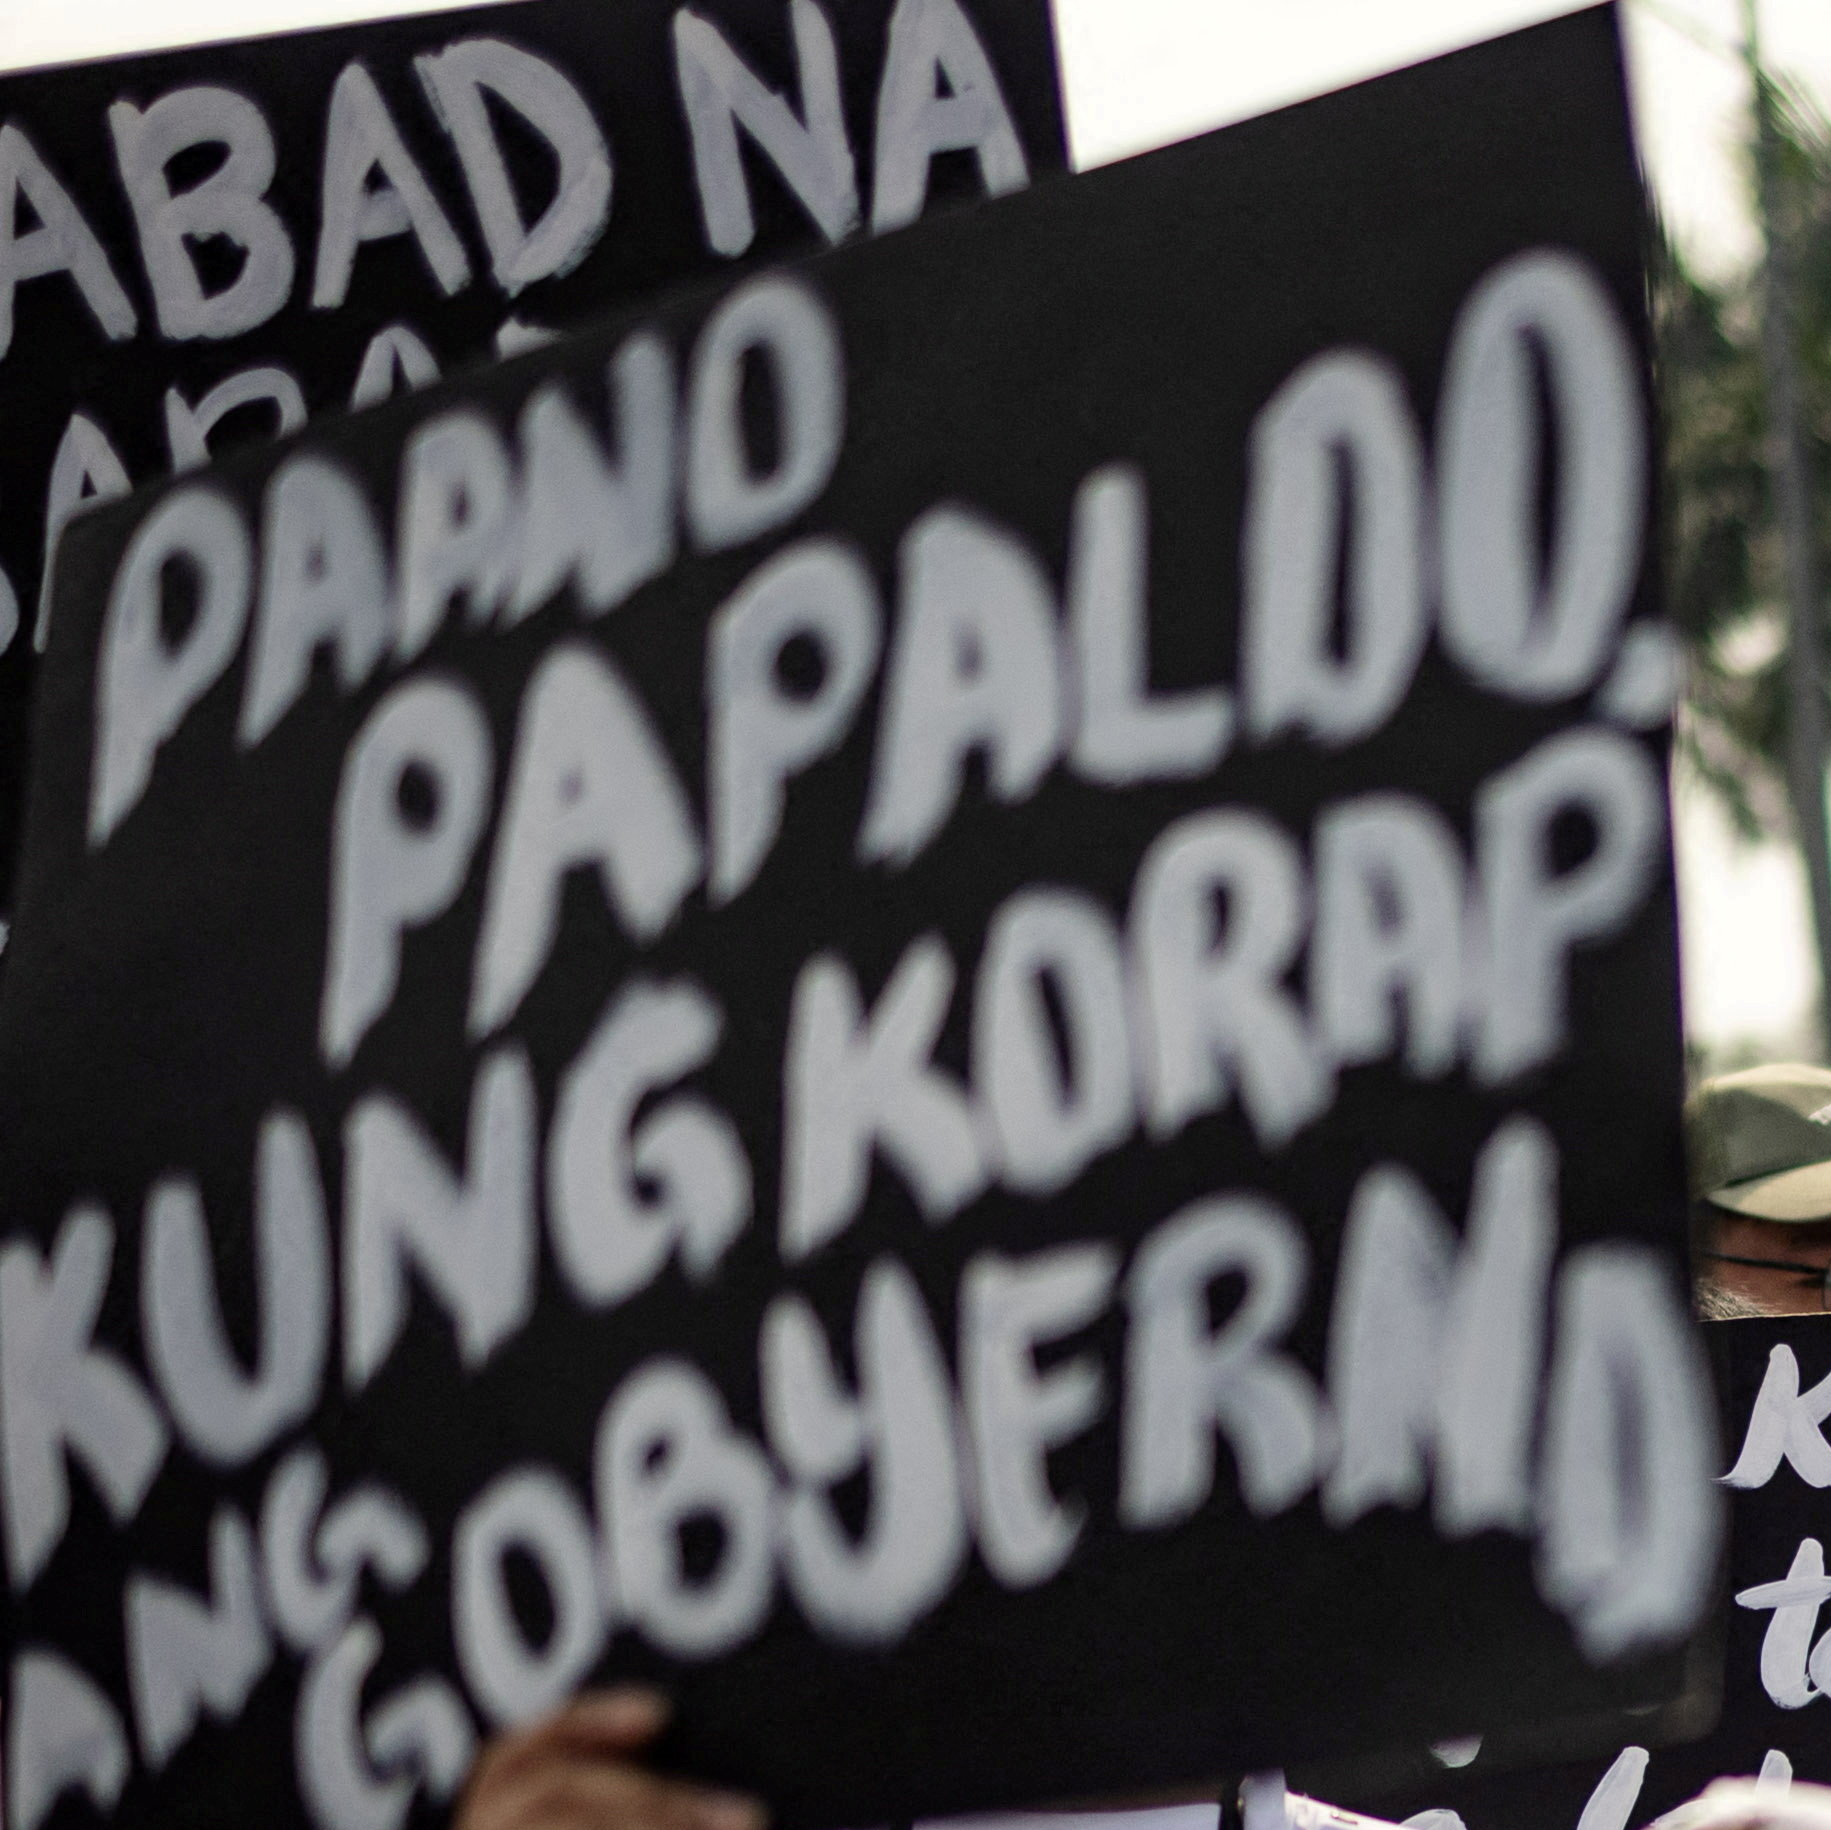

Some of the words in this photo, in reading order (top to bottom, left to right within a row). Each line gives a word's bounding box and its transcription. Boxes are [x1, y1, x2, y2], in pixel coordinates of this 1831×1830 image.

[673, 0, 1028, 257] NA
[88, 273, 846, 848] PAANO
[0, 980, 755, 1592] KUNG
[778, 725, 1664, 1266] KORAP
